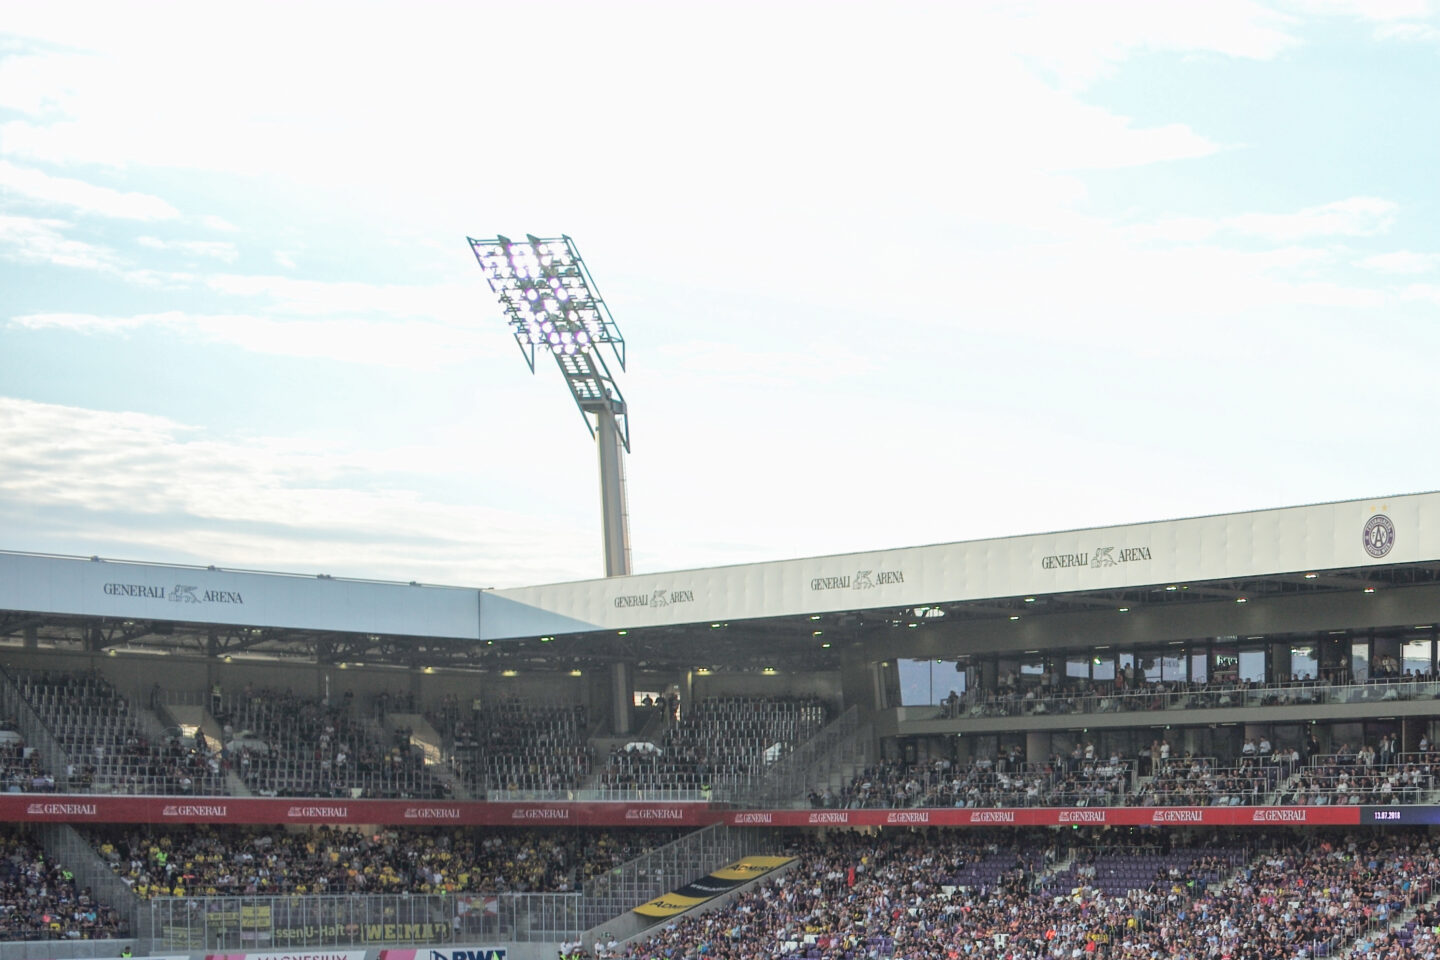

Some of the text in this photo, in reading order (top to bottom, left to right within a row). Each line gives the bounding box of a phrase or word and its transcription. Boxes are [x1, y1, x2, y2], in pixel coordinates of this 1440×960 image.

[1041, 546, 1152, 570] GENERALI ARENA
[810, 571, 904, 591] GENERALI ARENA
[103, 582, 244, 604] GENERALI ARENA
[613, 591, 694, 608] GENERALI ARENA
[44, 804, 96, 815] GENERALI
[178, 805, 226, 816] GENERALI
[302, 807, 347, 817] GENERALI
[418, 808, 460, 818] GENERALI
[525, 809, 569, 819] GENERALI
[639, 809, 683, 819] GENERALI
[1265, 809, 1306, 821] GENERALI
[818, 813, 848, 823] GENERALI
[897, 812, 928, 822] GENERALI
[980, 811, 1014, 822] GENERALI
[1069, 811, 1105, 822] GENERALI
[1164, 810, 1202, 821] GENERALI
